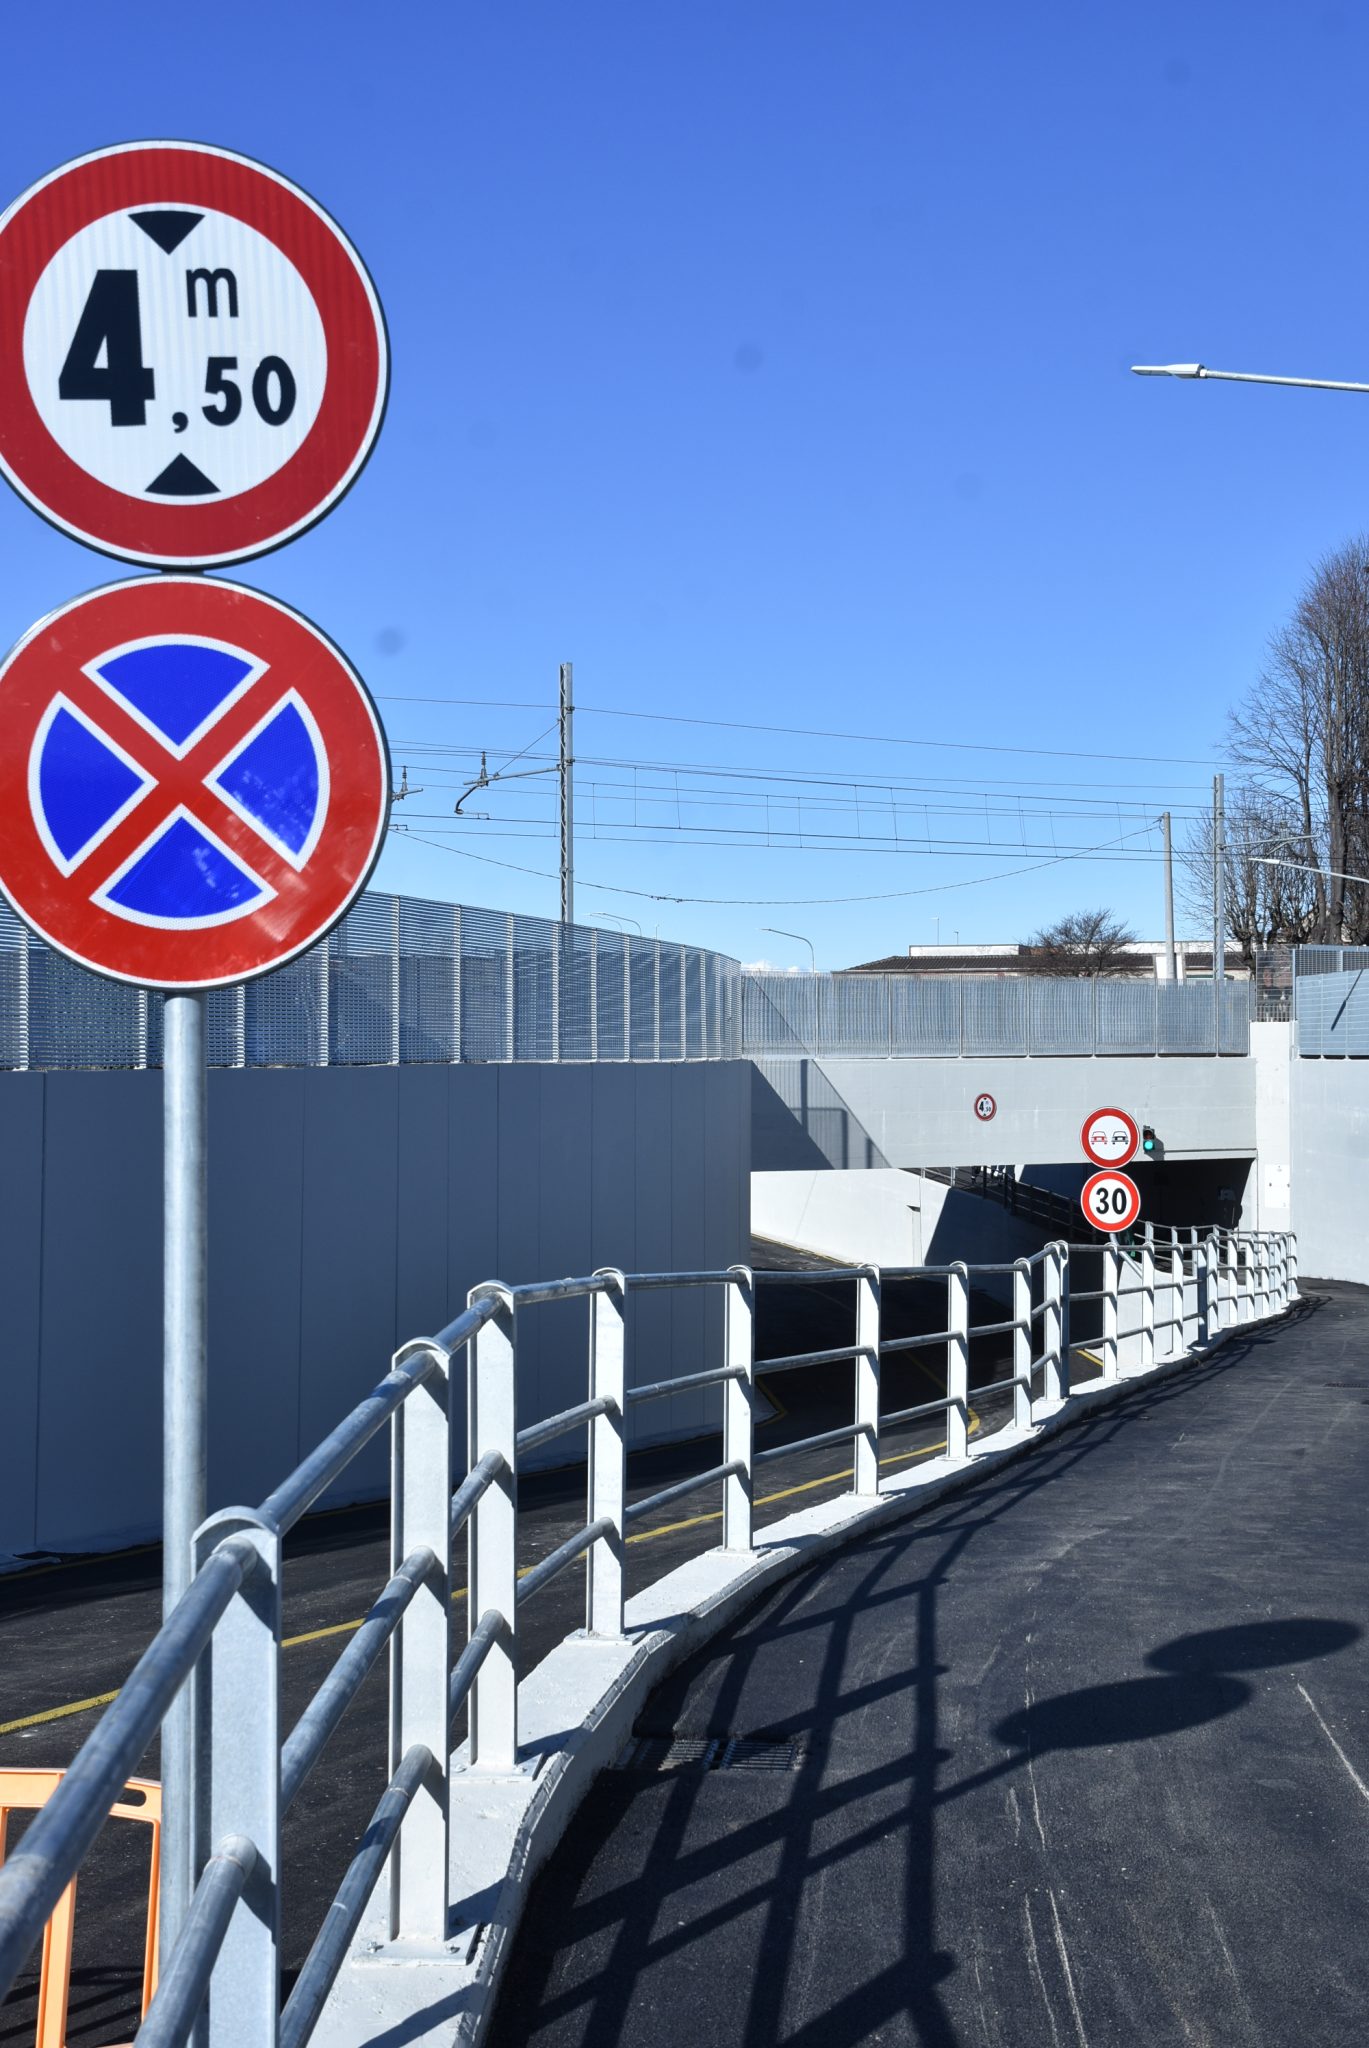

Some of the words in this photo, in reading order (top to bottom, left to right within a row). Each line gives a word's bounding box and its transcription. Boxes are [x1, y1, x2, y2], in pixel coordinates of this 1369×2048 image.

[186, 267, 239, 318] m
[59, 269, 297, 433] 4,50
[1096, 1187, 1127, 1215] 30
